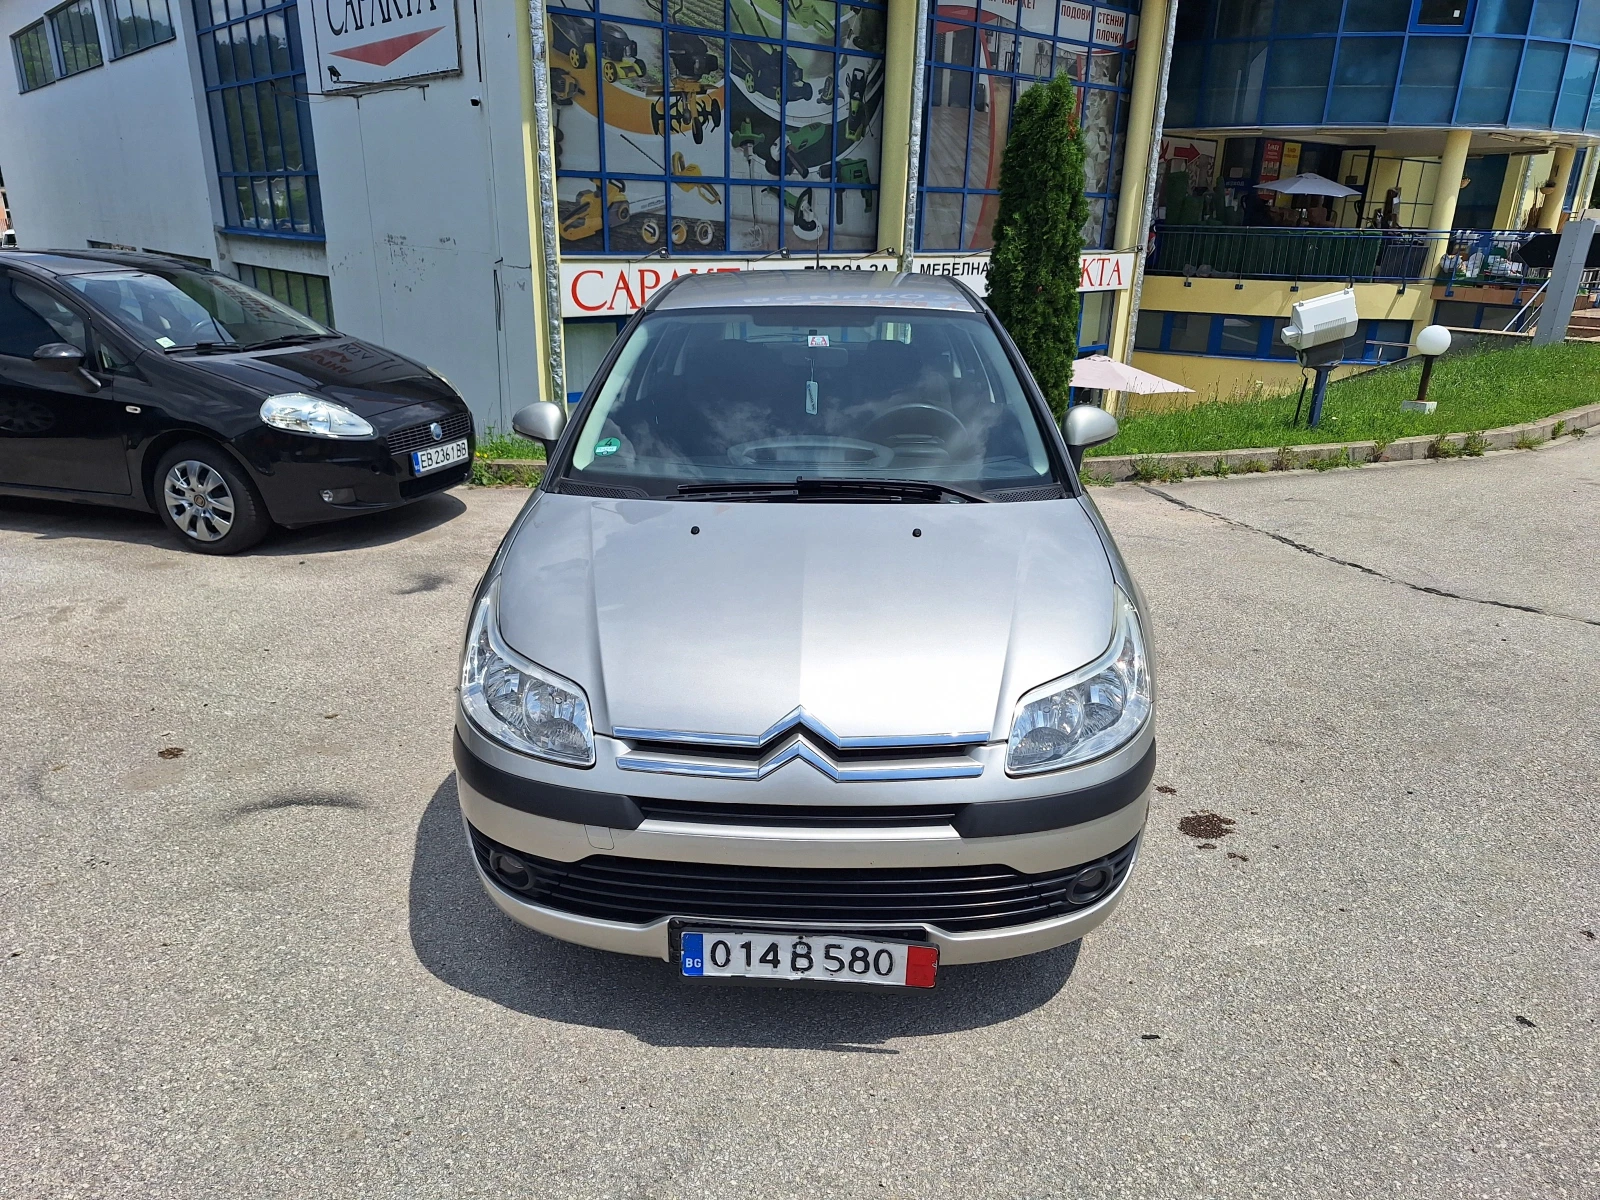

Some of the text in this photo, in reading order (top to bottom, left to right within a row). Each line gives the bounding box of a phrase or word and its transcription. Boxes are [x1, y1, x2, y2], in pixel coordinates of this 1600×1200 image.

[1061, 4, 1091, 21] ПОДОВИ
[1097, 11, 1124, 28] СТЕННИ
[1095, 28, 1124, 44] ПЛОЧКИ
[434, 445, 456, 465] 2361
[685, 957, 702, 969] BG
